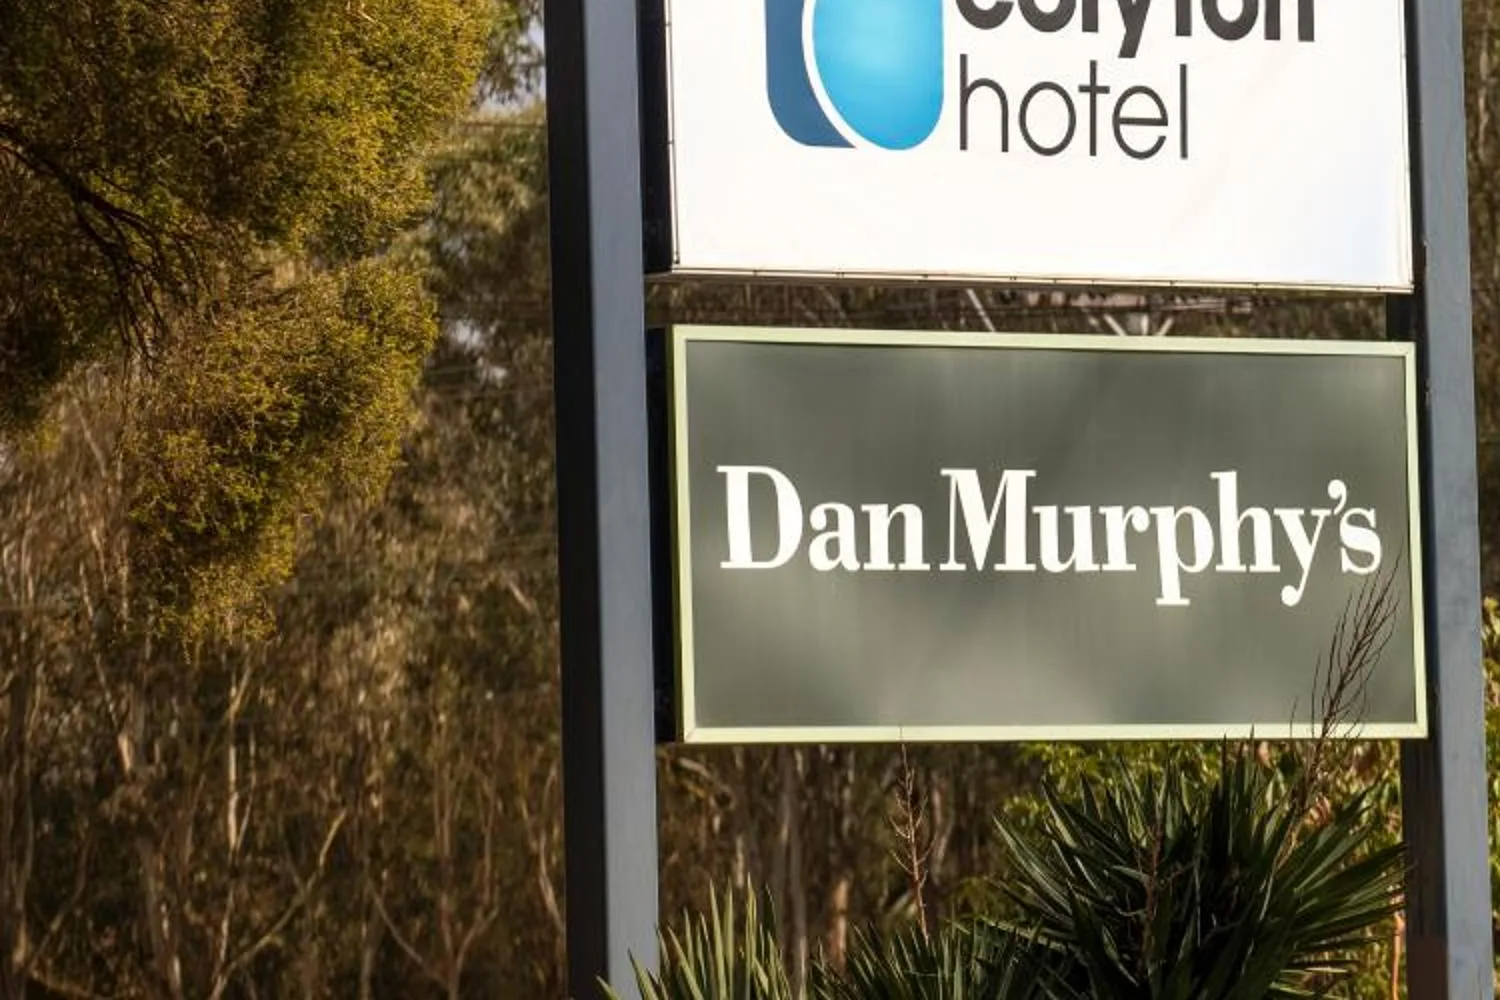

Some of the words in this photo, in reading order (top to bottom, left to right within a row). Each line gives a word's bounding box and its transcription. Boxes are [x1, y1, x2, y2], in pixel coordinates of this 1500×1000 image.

[959, 53, 1188, 161] hotel
[717, 465, 931, 572] Dan
[939, 468, 1382, 606] Murphy's
